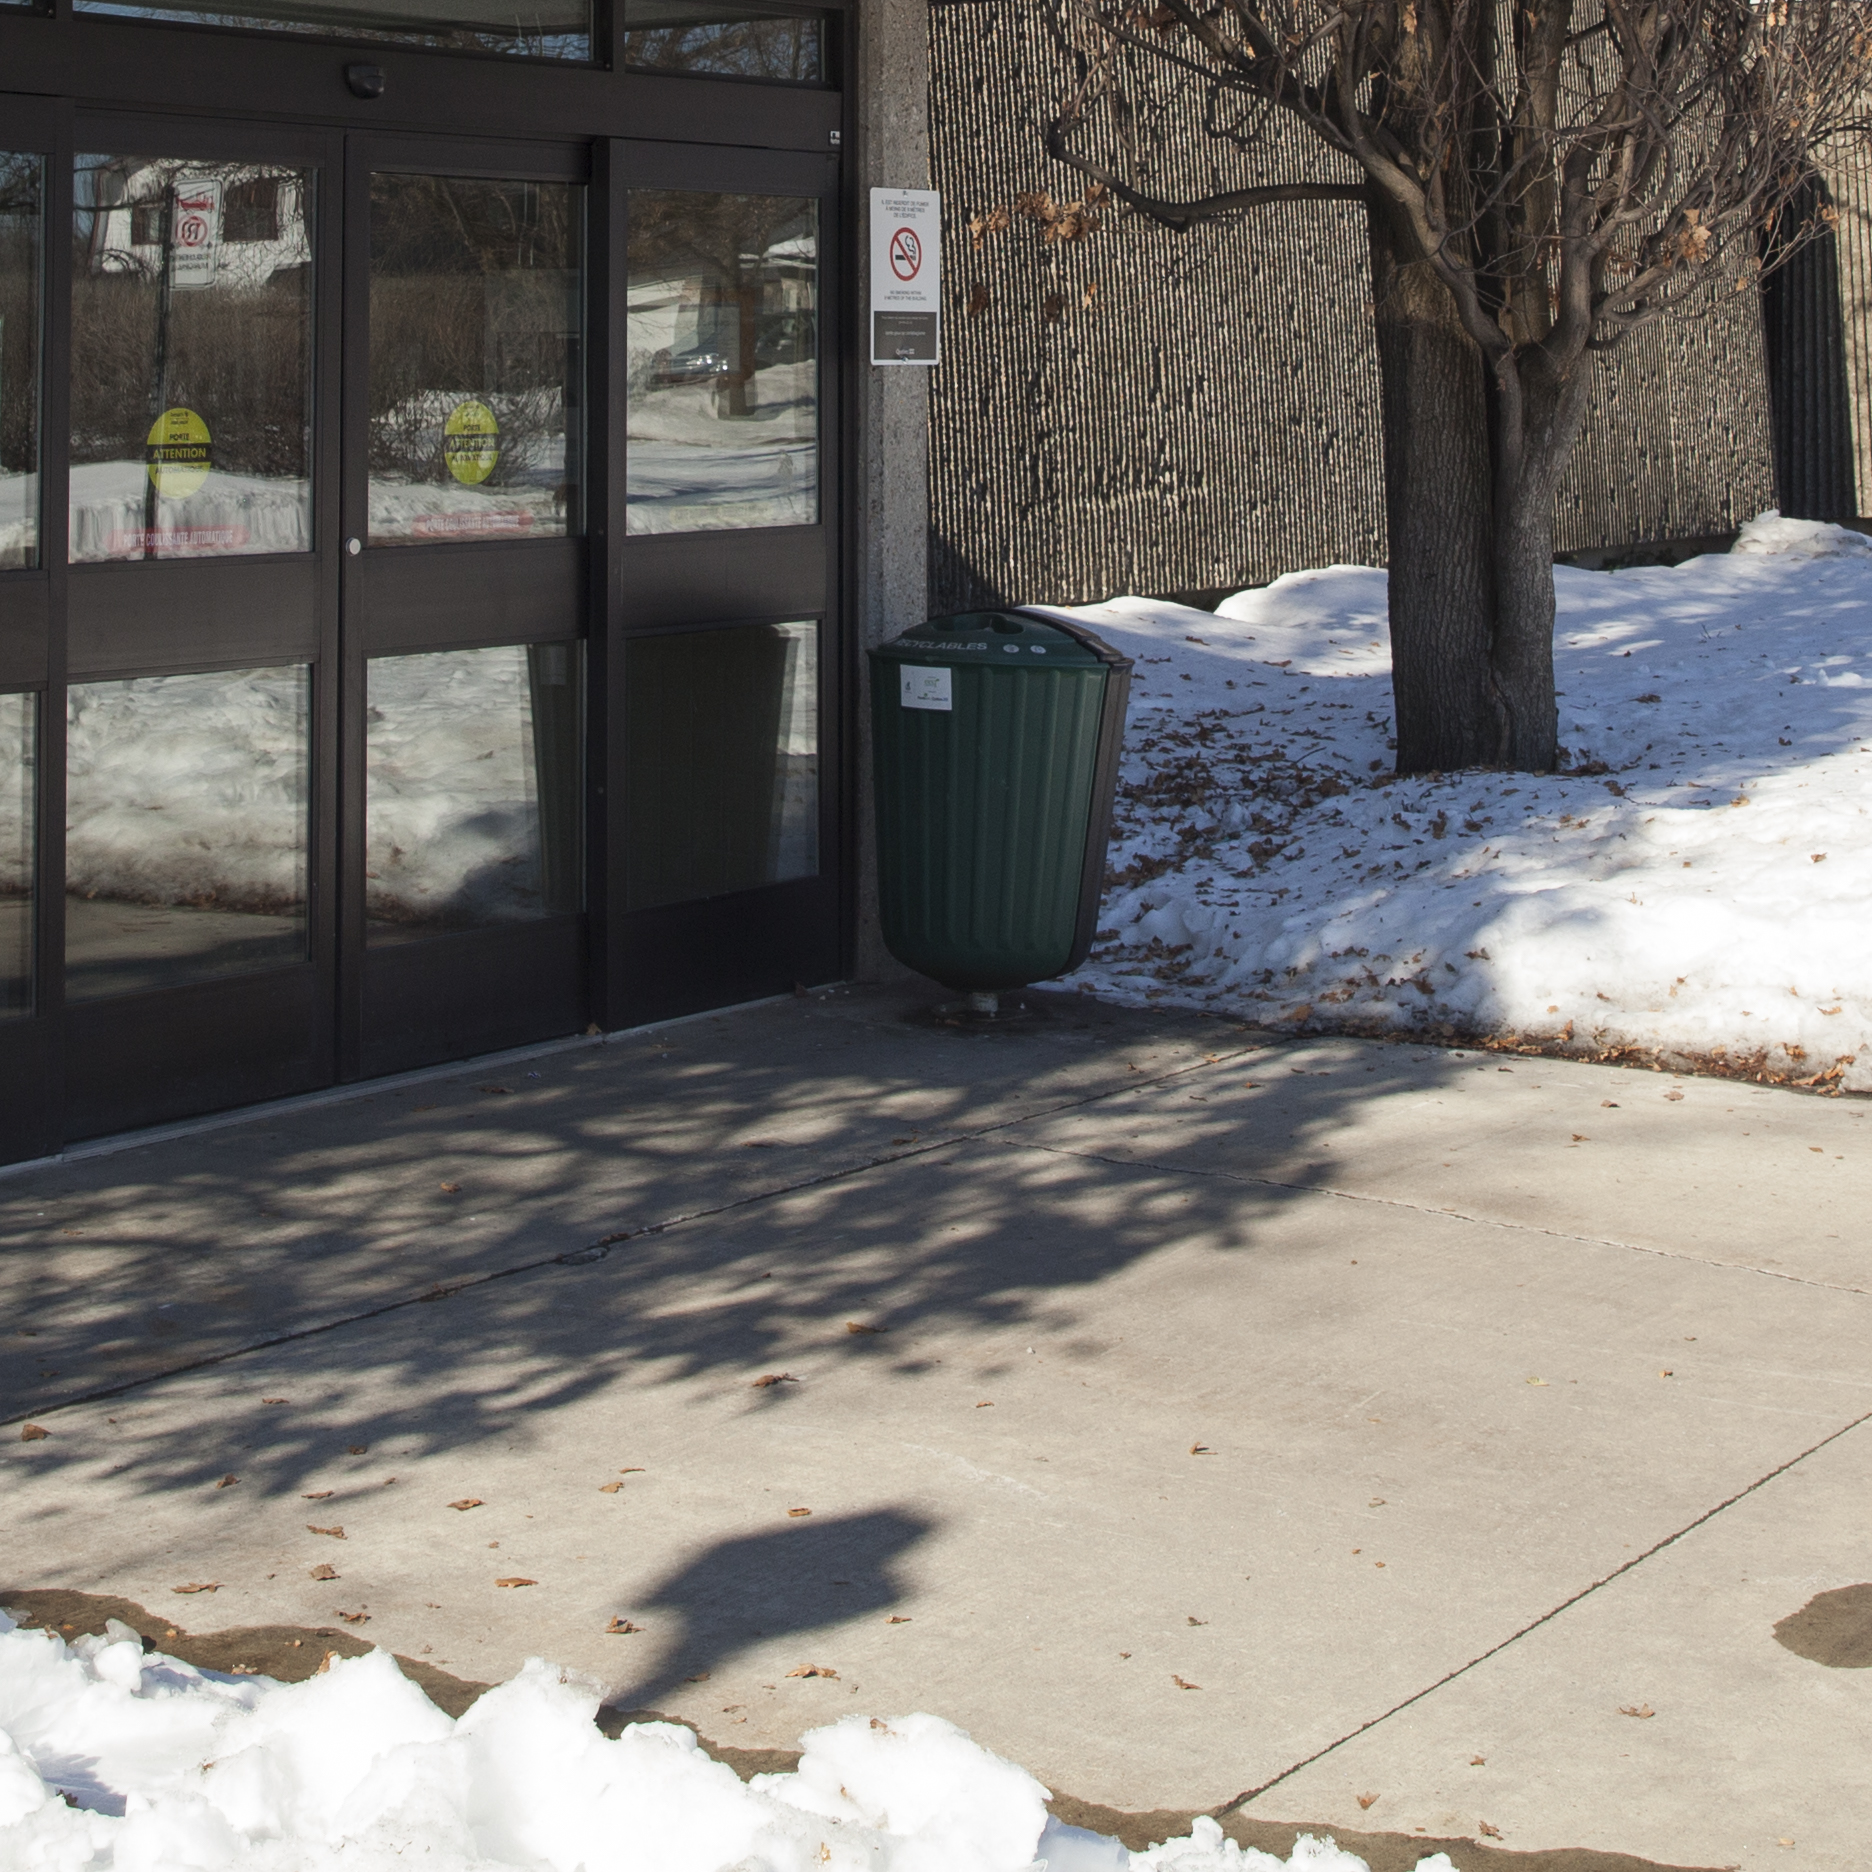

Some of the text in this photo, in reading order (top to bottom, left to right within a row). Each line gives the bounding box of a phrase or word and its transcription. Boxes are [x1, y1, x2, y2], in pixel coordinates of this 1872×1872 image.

[169, 433, 190, 441] PORTE
[449, 437, 495, 450] ATTENTION
[153, 447, 207, 459] ATTENTION
[123, 529, 233, 547] PORTE COULISSANTE AUTOMATIQUE
